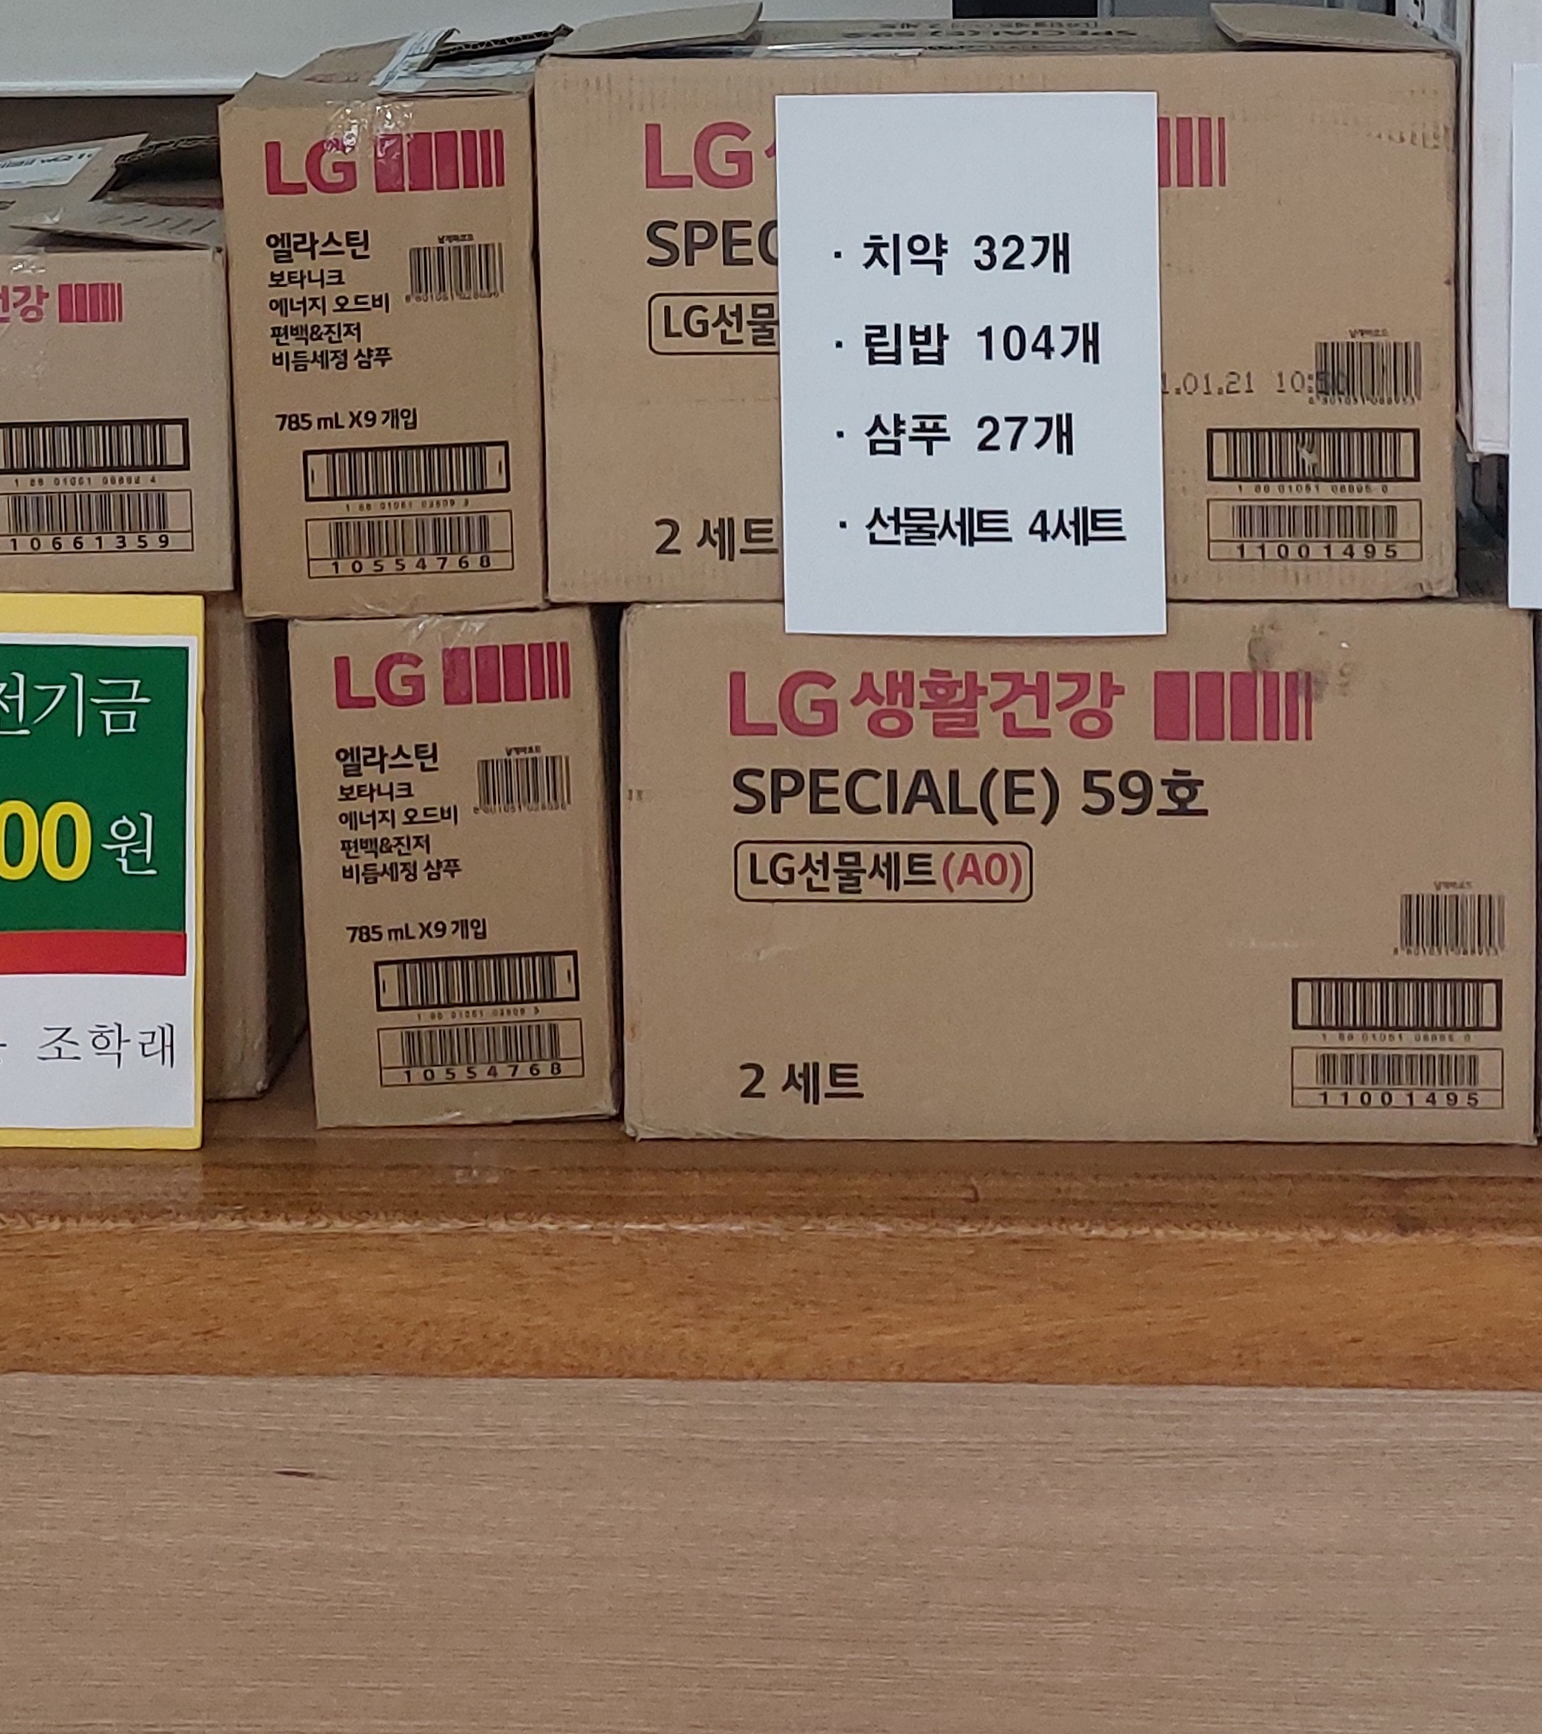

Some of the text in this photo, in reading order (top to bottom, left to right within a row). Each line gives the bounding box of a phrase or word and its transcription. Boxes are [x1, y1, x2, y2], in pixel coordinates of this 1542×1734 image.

[264, 137, 358, 196] LG
[265, 229, 371, 264] 엘라스틴
[861, 230, 1071, 276] 치약 32개
[267, 268, 346, 290] 보타니크
[269, 293, 328, 318] 에너지
[332, 291, 391, 315] 오드비
[270, 321, 362, 347] 편백&진저
[863, 321, 1102, 366] 립밥 104개
[271, 346, 393, 373] 비듬세정 샴푸
[275, 412, 314, 433] 785
[380, 407, 418, 431] 개입
[863, 411, 1076, 457] 샴푸 27개
[654, 516, 779, 562] 2 세트
[863, 504, 1127, 548] 선물세트 4세트
[8, 534, 171, 553] 10661359
[1236, 543, 1398, 559] 11001495
[332, 554, 492, 575] 10554768
[333, 651, 426, 710] LG
[334, 741, 440, 778] 엘라스틴
[336, 781, 415, 804] 보타니크
[730, 766, 1211, 827] SPECIAL(E) 59호
[337, 807, 397, 831] 에너지
[400, 803, 459, 827] 오드비
[101, 810, 159, 878] 원
[339, 834, 431, 860] 편백&진저
[341, 858, 463, 885] 비듬세정 샴푸
[346, 924, 383, 944] 785
[450, 916, 489, 941] 개입
[36, 1021, 178, 1069] 조학래
[404, 1062, 563, 1084] 10554768
[738, 1061, 866, 1107] 2 세트
[1318, 1091, 1479, 1108] 11001495
